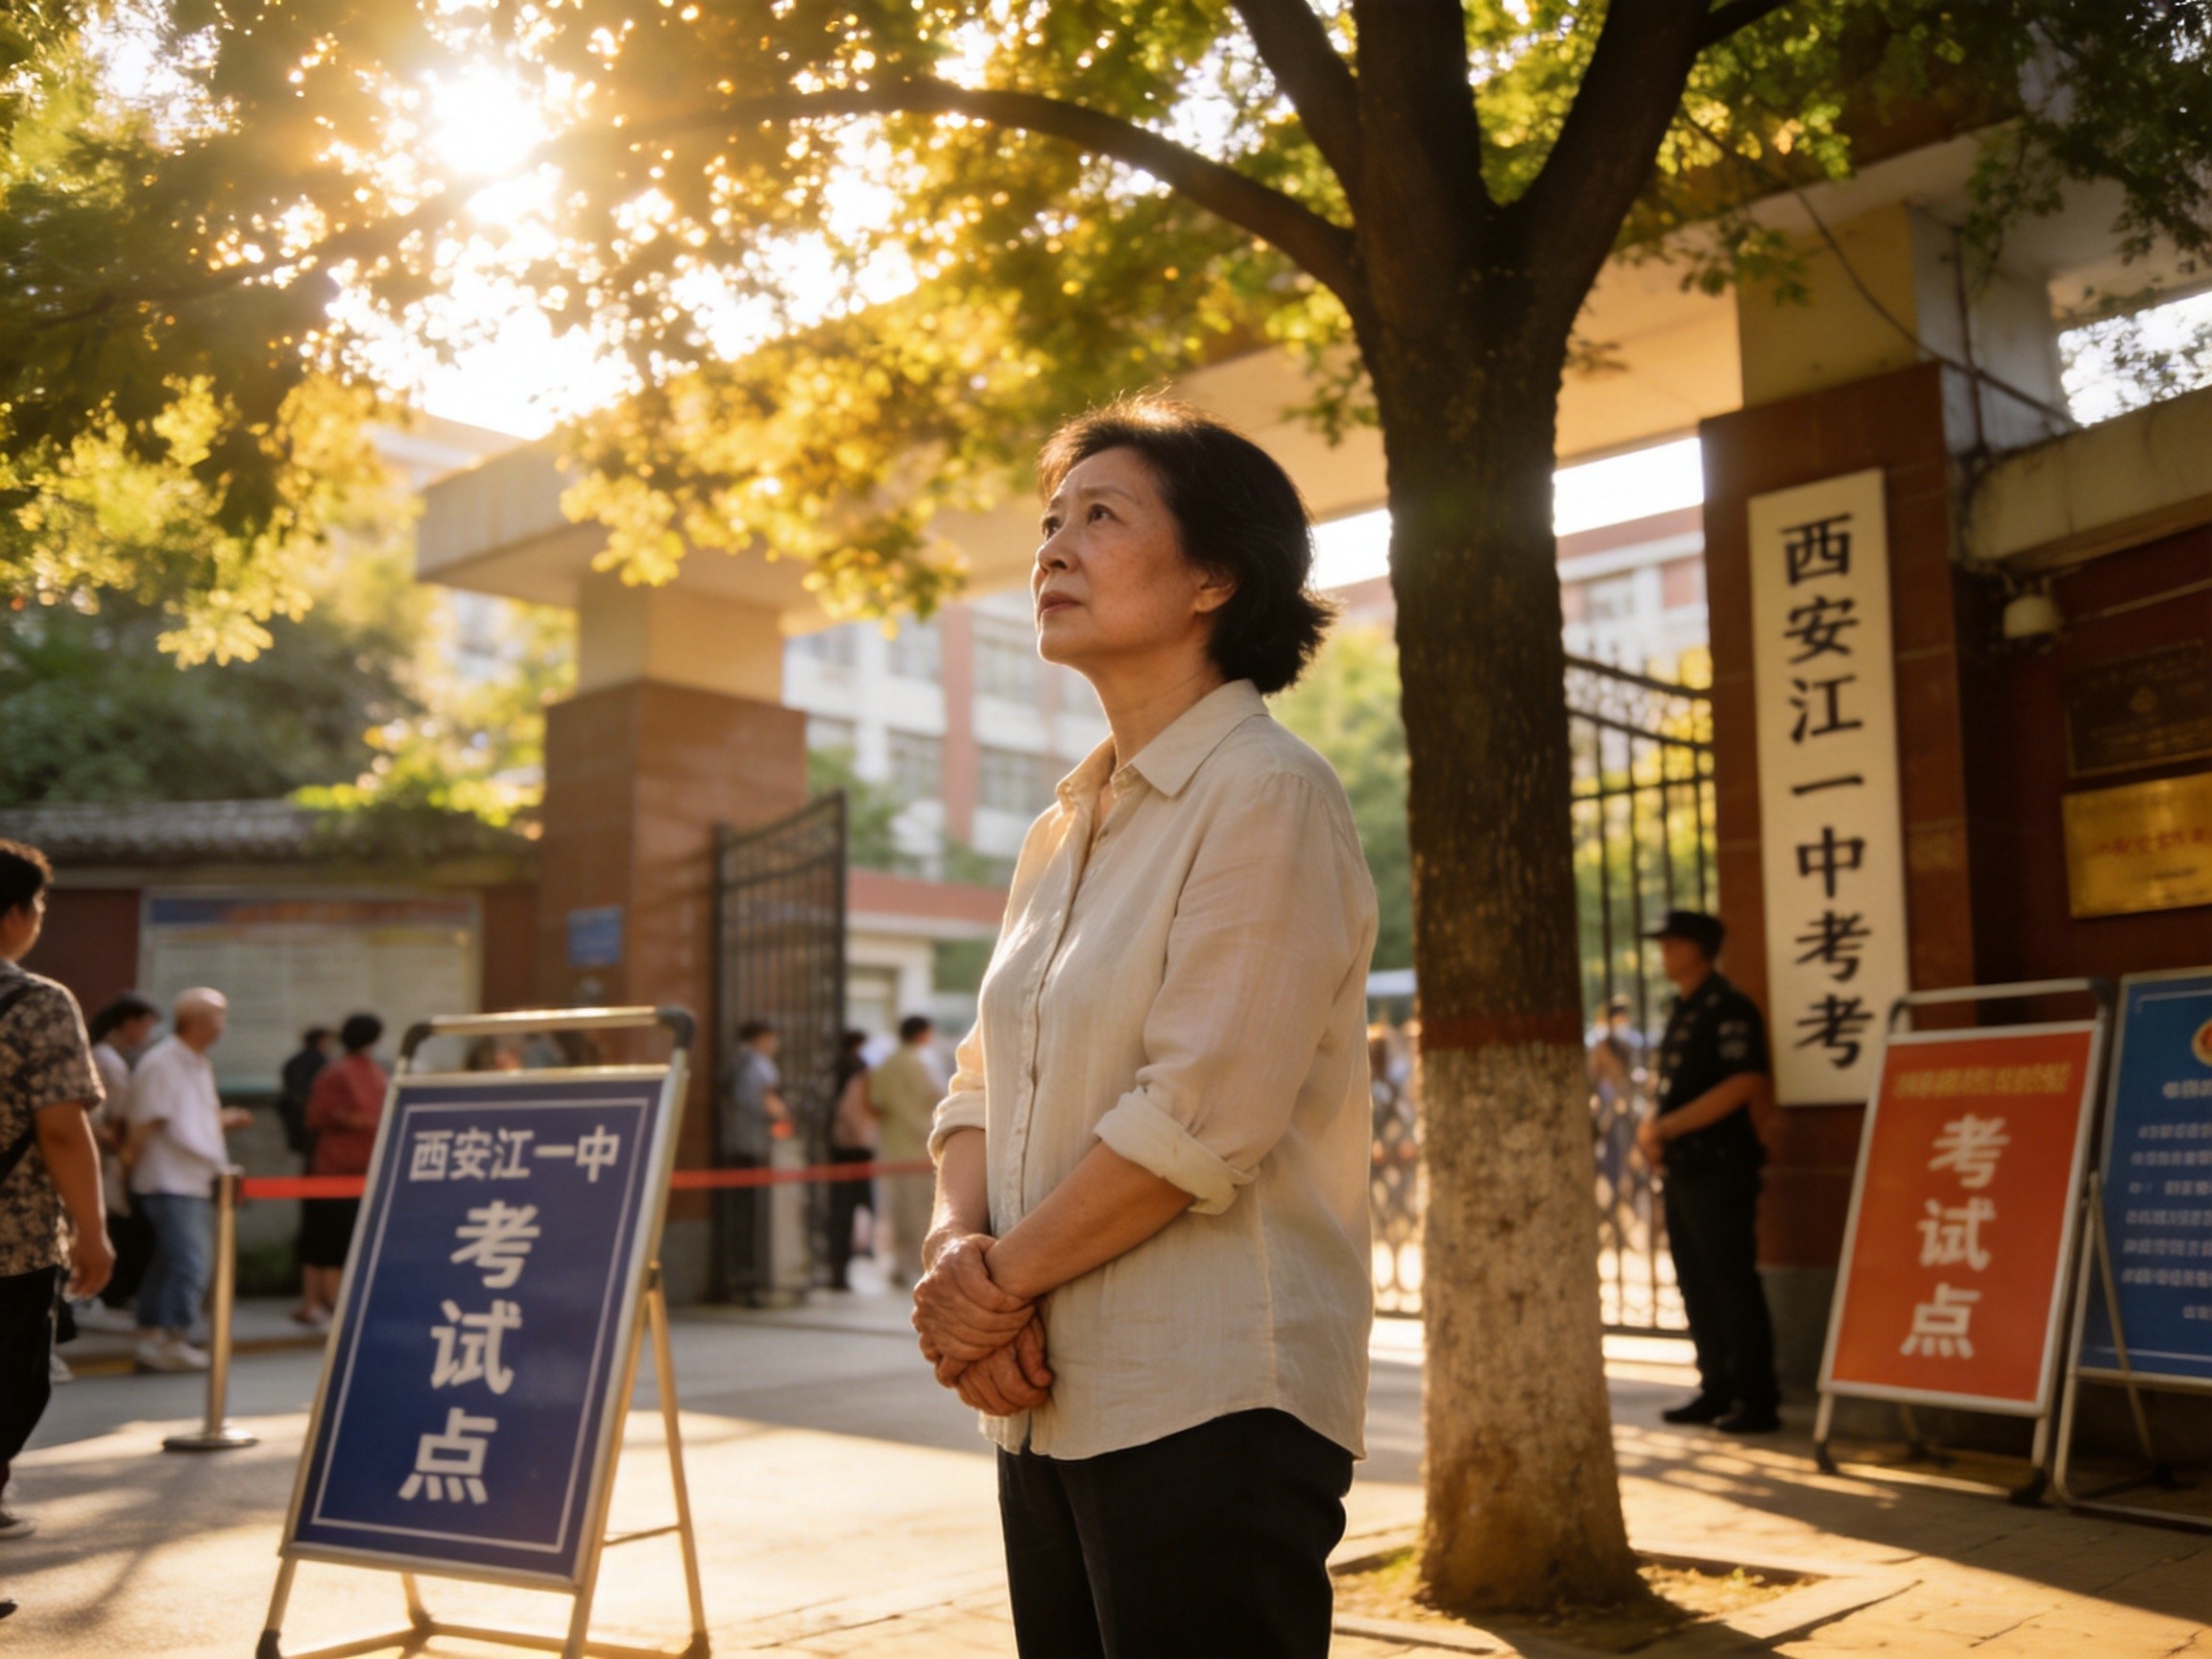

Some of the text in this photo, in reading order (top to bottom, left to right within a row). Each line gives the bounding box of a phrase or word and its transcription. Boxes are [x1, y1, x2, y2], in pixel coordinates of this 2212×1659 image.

[1780, 513, 1874, 1069] 西安江一中考考
[408, 1124, 621, 1183] 西安江一中
[1899, 1113, 2010, 1359] 考试点
[397, 1199, 541, 1504] 考试点
